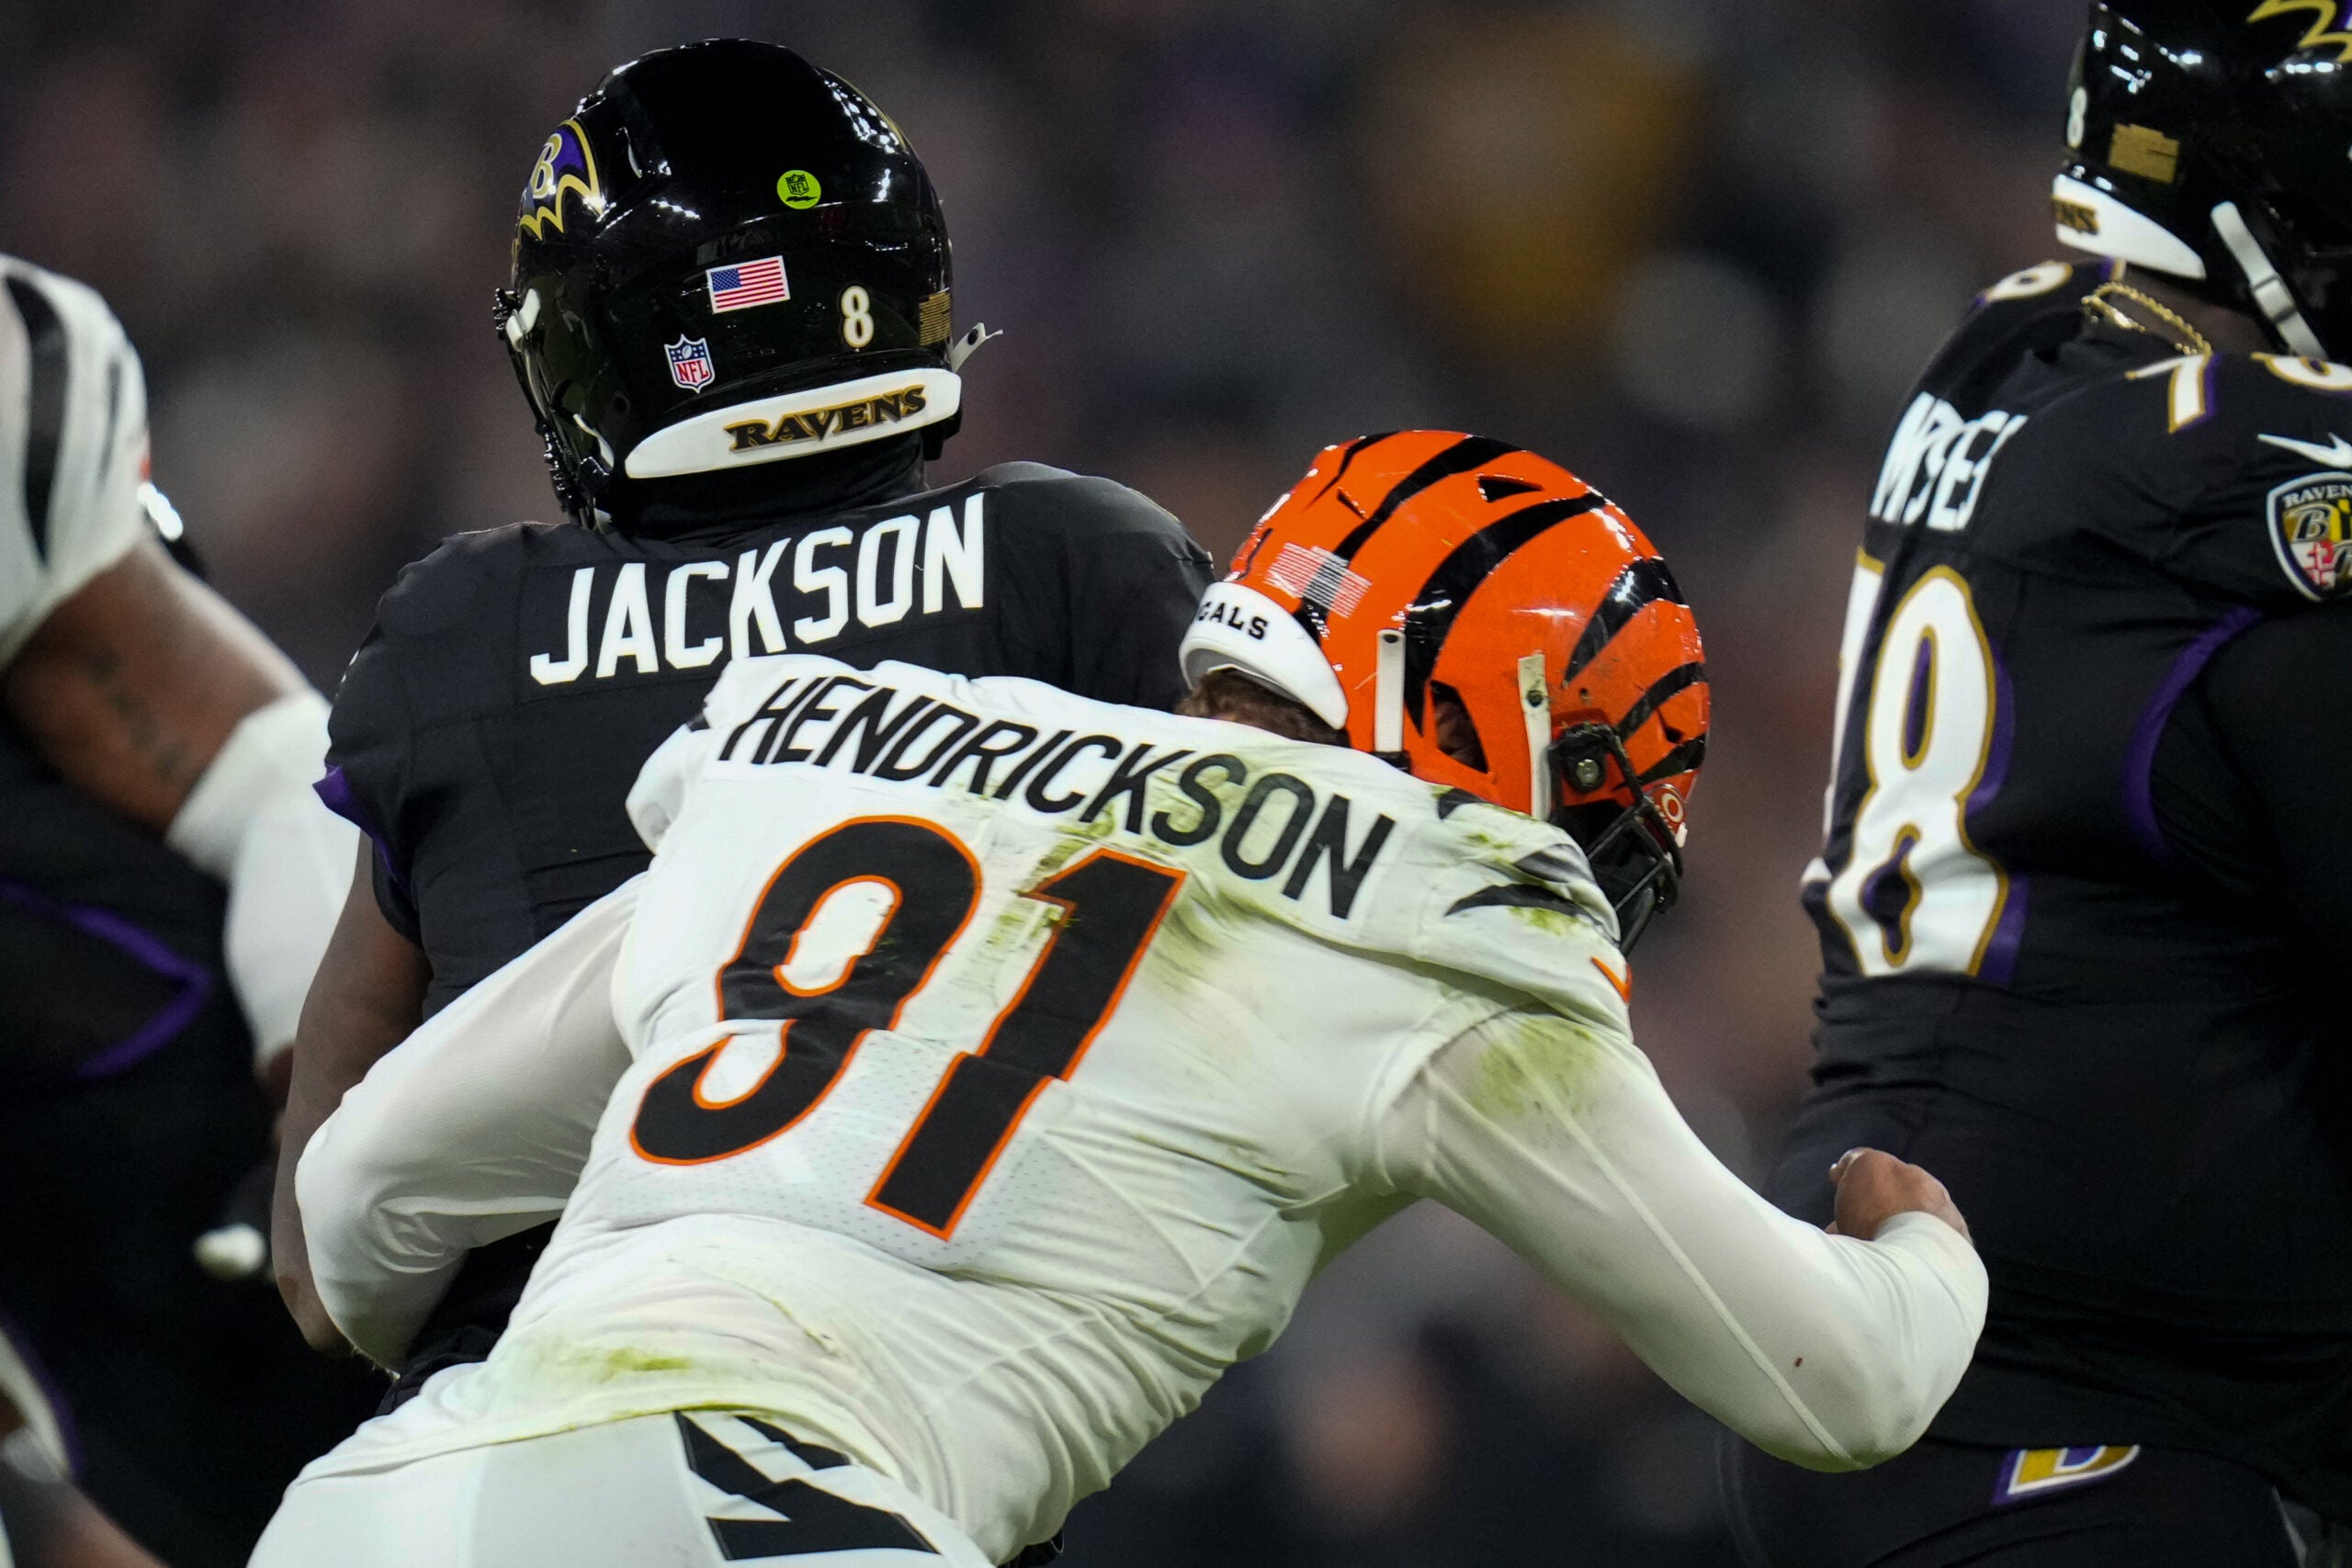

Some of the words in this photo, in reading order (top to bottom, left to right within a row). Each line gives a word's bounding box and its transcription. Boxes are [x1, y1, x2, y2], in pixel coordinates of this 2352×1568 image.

[675, 360, 709, 383] NFL
[841, 285, 874, 348] 8
[723, 384, 927, 454] RAVENS
[529, 492, 985, 685] JACKSON
[718, 676, 1396, 919] HENDRICKSON
[629, 814, 1187, 1242] 91
